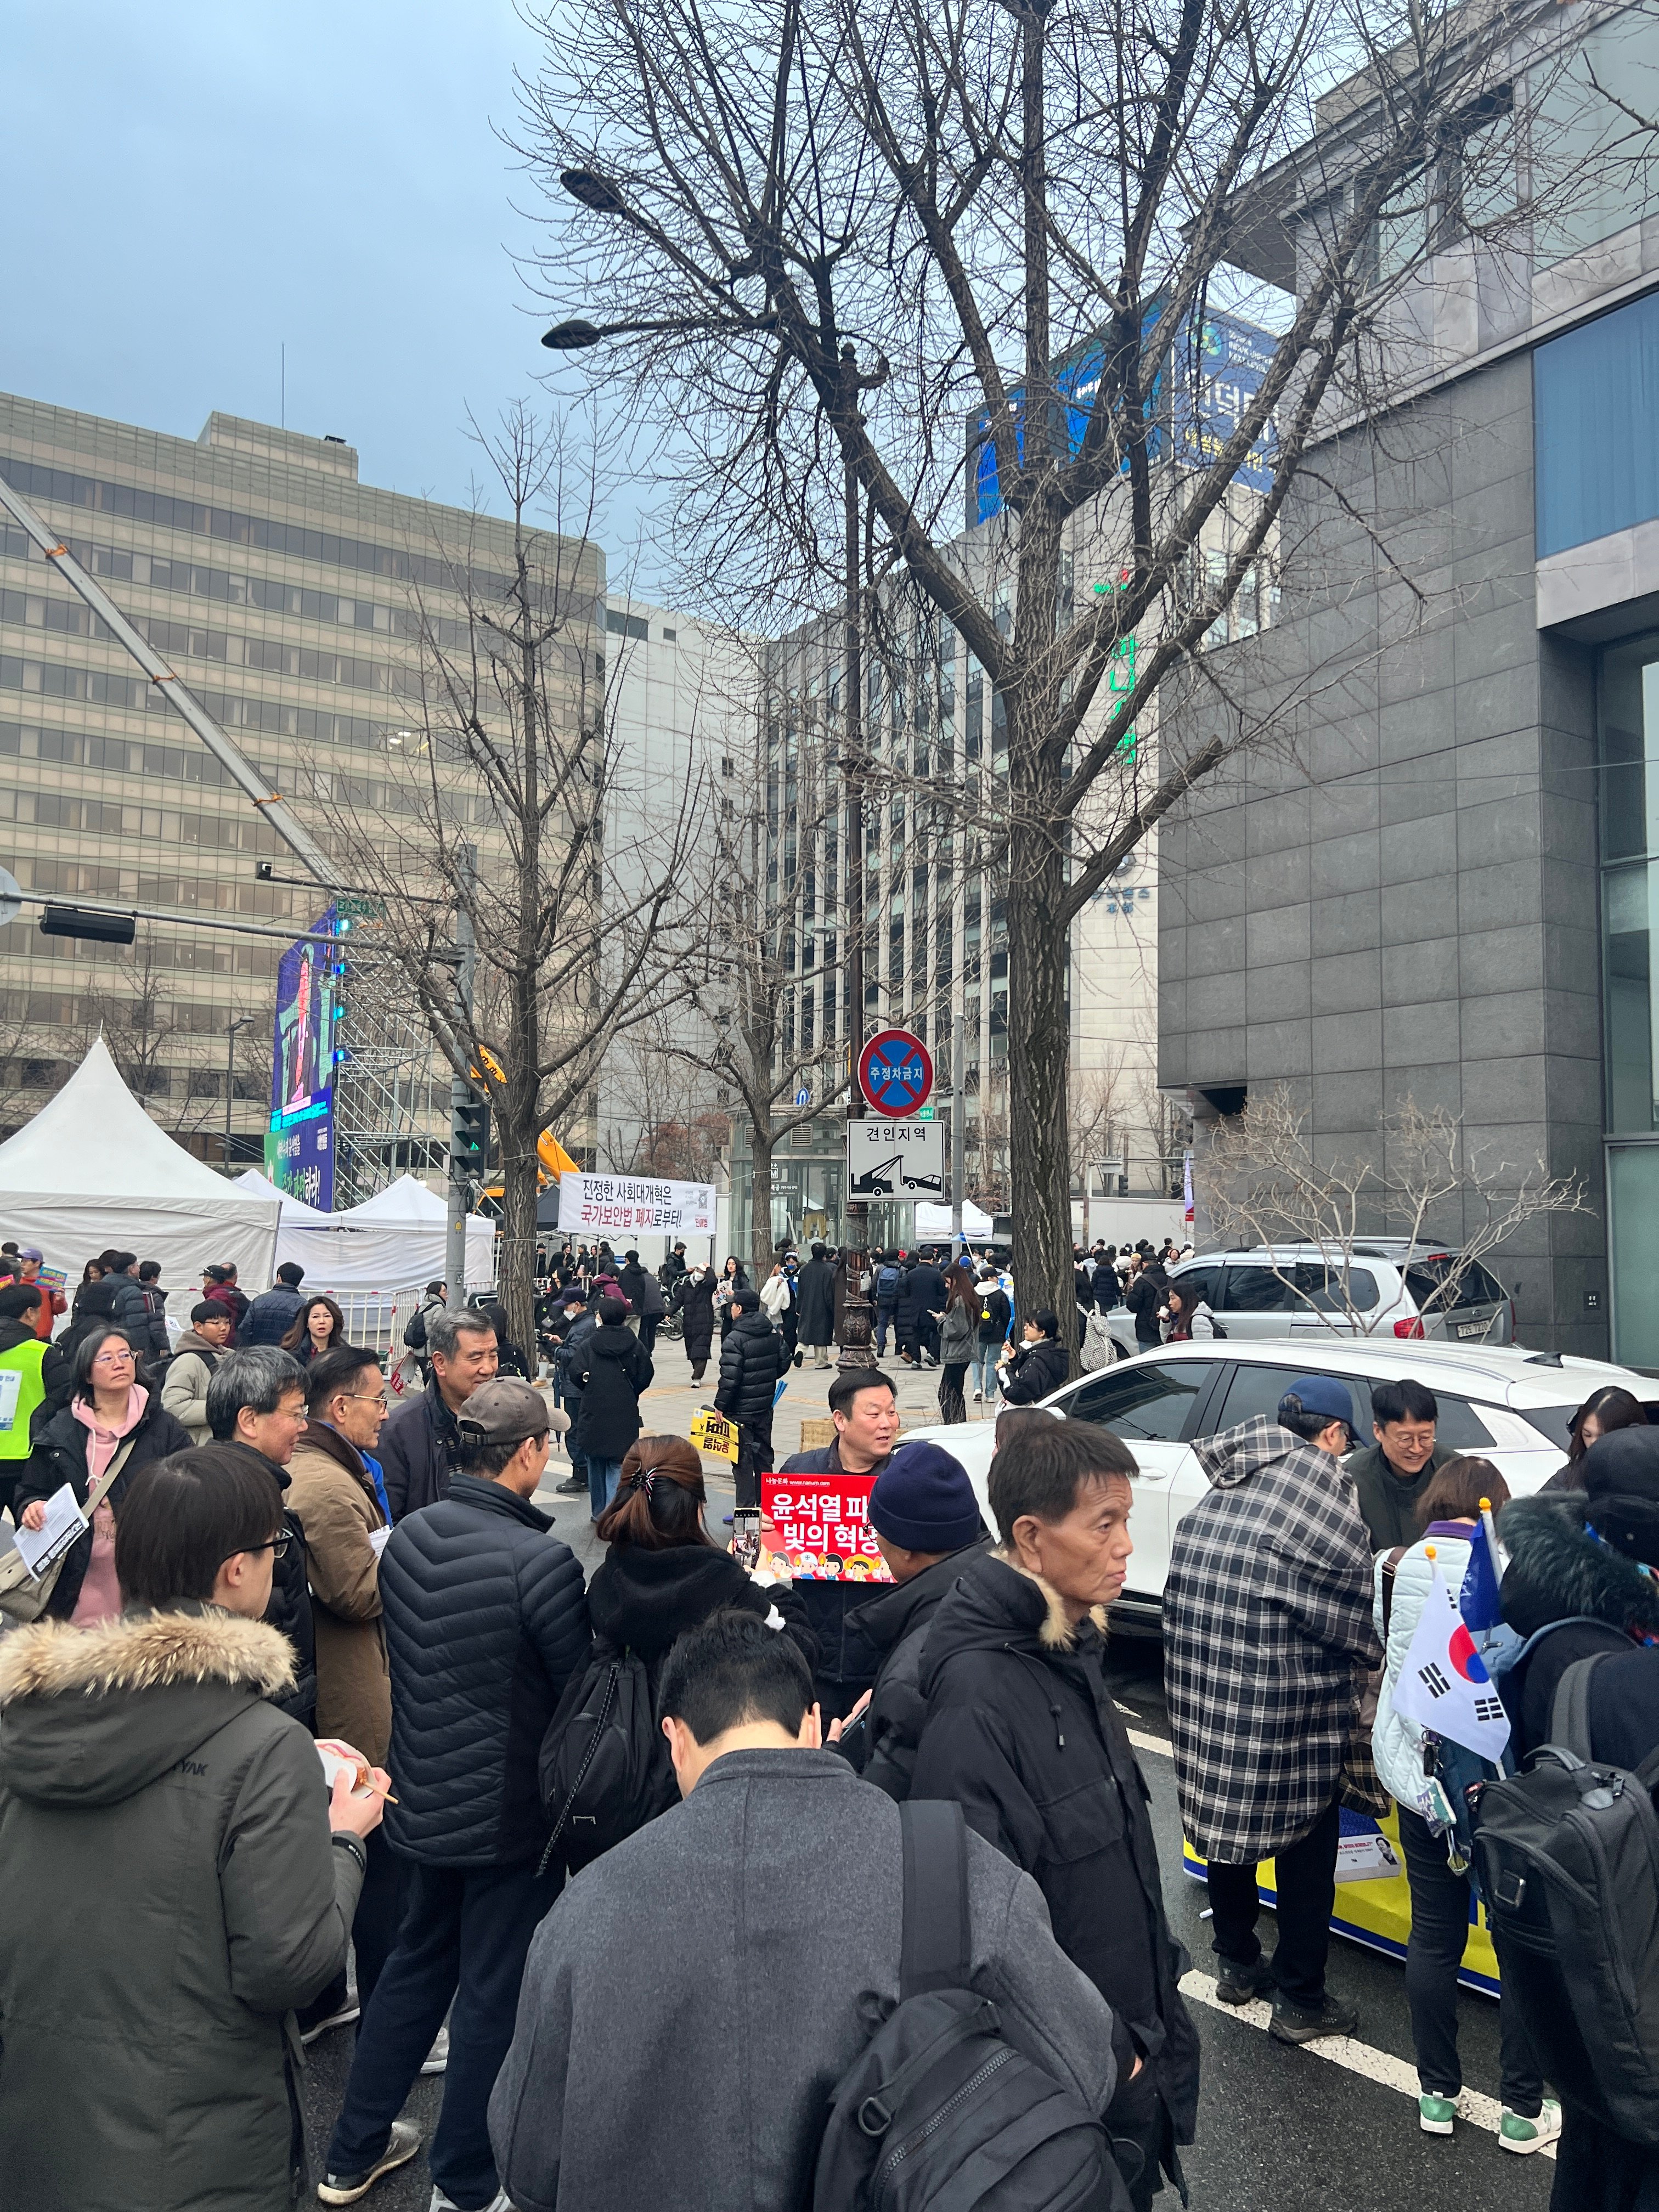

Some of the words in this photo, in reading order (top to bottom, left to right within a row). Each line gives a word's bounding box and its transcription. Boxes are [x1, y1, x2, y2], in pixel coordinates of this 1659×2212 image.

[870, 1066, 923, 1081] 주정차금지
[867, 1126, 926, 1142] 견인지역
[583, 1179, 613, 1202] 진정한
[617, 1182, 672, 1205] 사회대개혁은
[581, 1204, 633, 1228] 국가보안법
[635, 1208, 682, 1228] 폐지로부터!
[703, 1437, 730, 1454] 윤석열
[771, 1493, 841, 1522] 윤석열
[845, 1495, 870, 1523] 파
[783, 1523, 828, 1553] 빛의
[834, 1524, 879, 1554] 혁명
[180, 1759, 209, 1776] YAK
